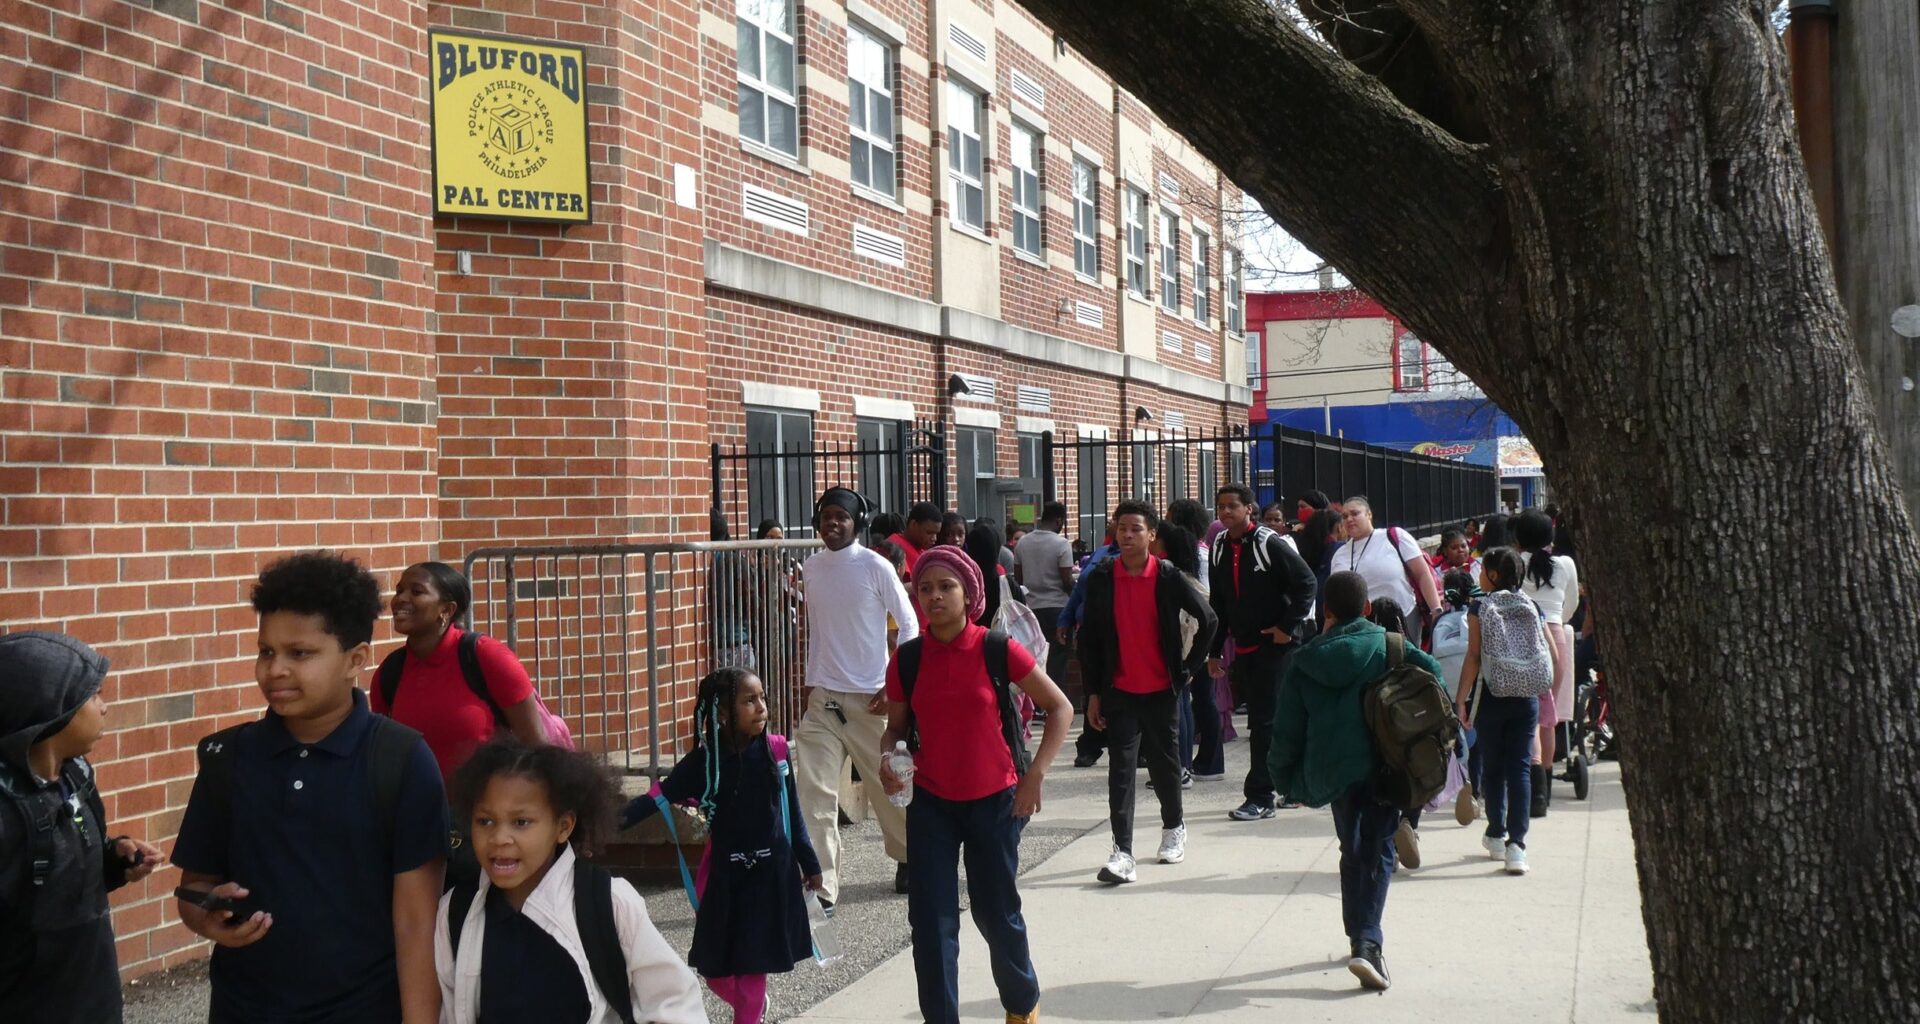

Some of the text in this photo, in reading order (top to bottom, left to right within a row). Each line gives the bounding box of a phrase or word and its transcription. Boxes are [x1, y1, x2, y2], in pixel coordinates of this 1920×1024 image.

[437, 41, 580, 105] BLUFORD
[468, 80, 554, 144] POLICE ATHLETIC LEAGUE
[478, 151, 548, 179] PHILADELPHIA
[444, 185, 584, 213] PAL CENTER
[1423, 443, 1476, 456] Master
